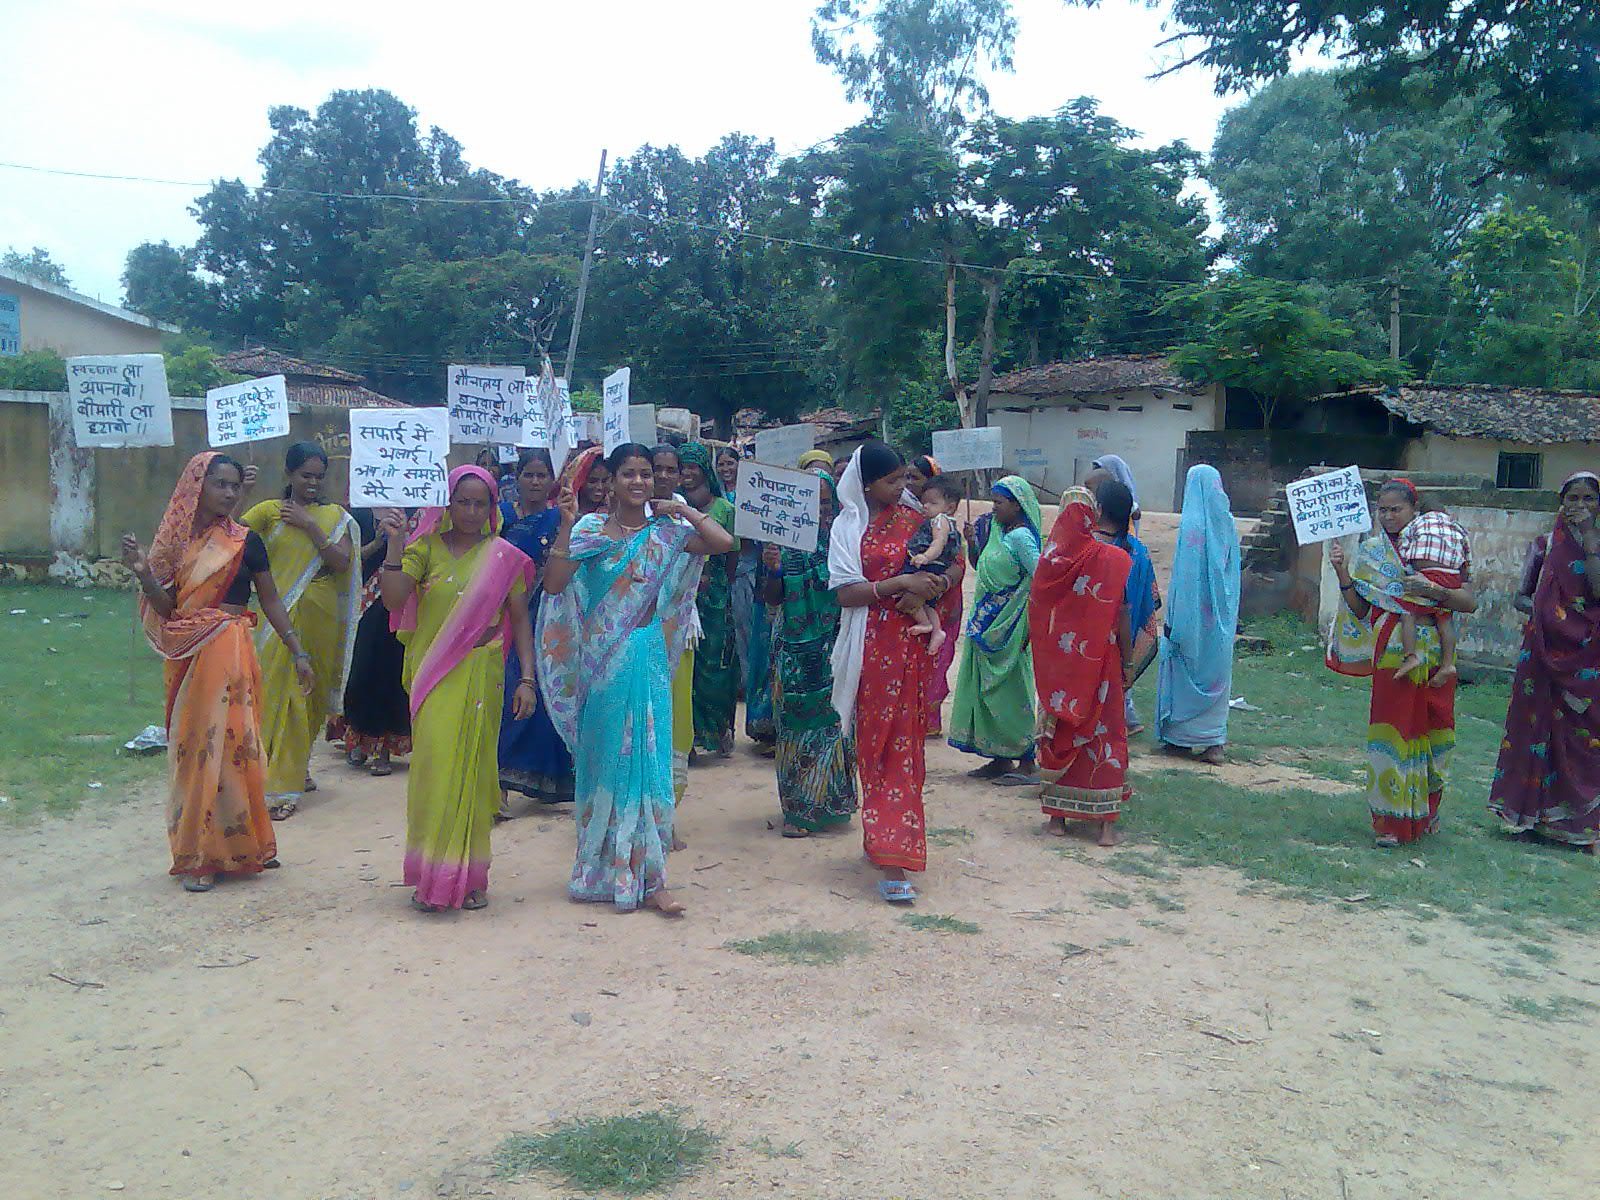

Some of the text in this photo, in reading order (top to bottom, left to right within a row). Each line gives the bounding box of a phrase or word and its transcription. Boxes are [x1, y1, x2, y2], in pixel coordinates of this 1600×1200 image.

[130, 405, 154, 421] ला
[359, 421, 407, 445] सफाई
[411, 423, 434, 442] में
[361, 479, 394, 499] मेरे
[402, 482, 432, 500] भाई
